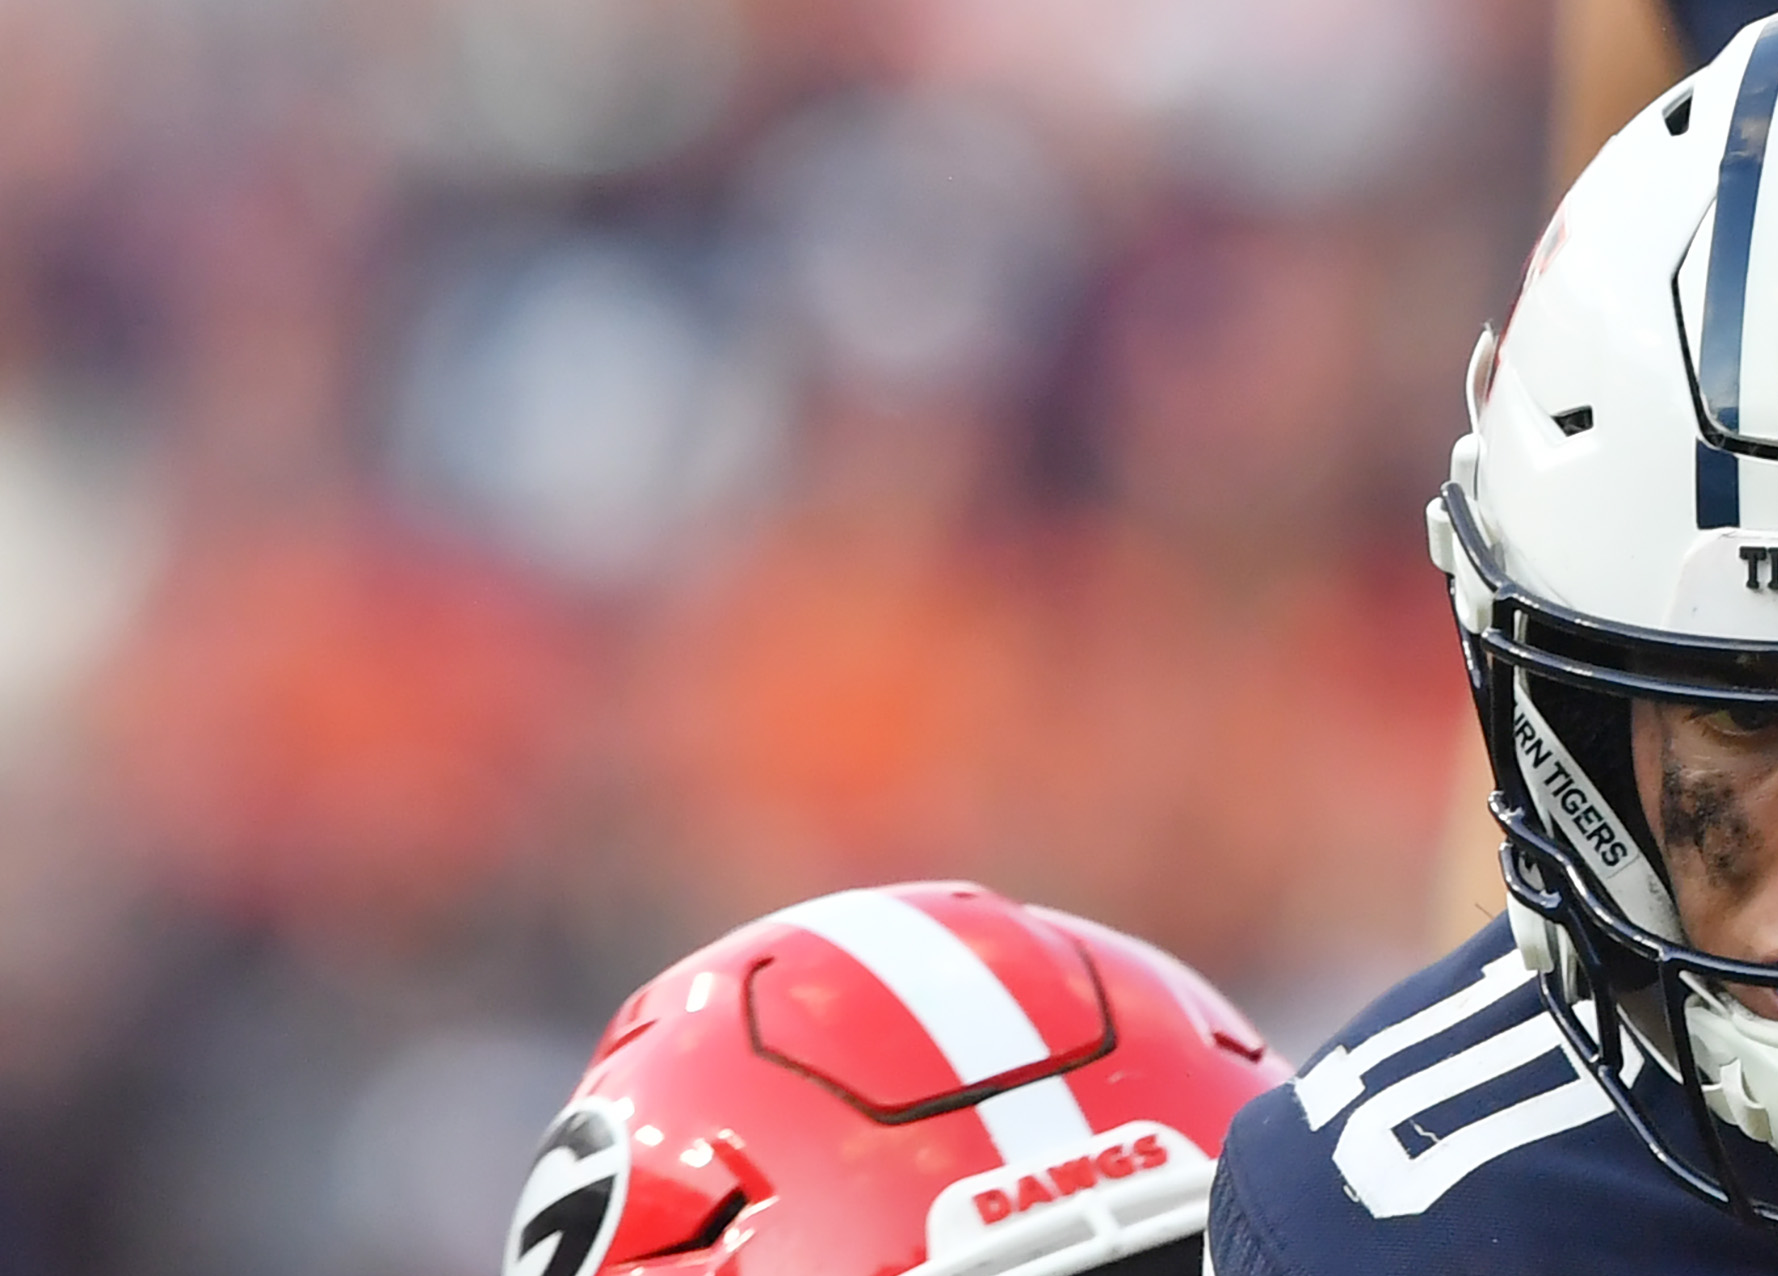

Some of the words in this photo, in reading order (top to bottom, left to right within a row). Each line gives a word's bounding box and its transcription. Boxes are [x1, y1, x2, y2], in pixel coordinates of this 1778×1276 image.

[1544, 761, 1628, 867] TIGERS
[1294, 948, 1644, 1219] 10
[972, 1134, 1167, 1225] DAWGS
